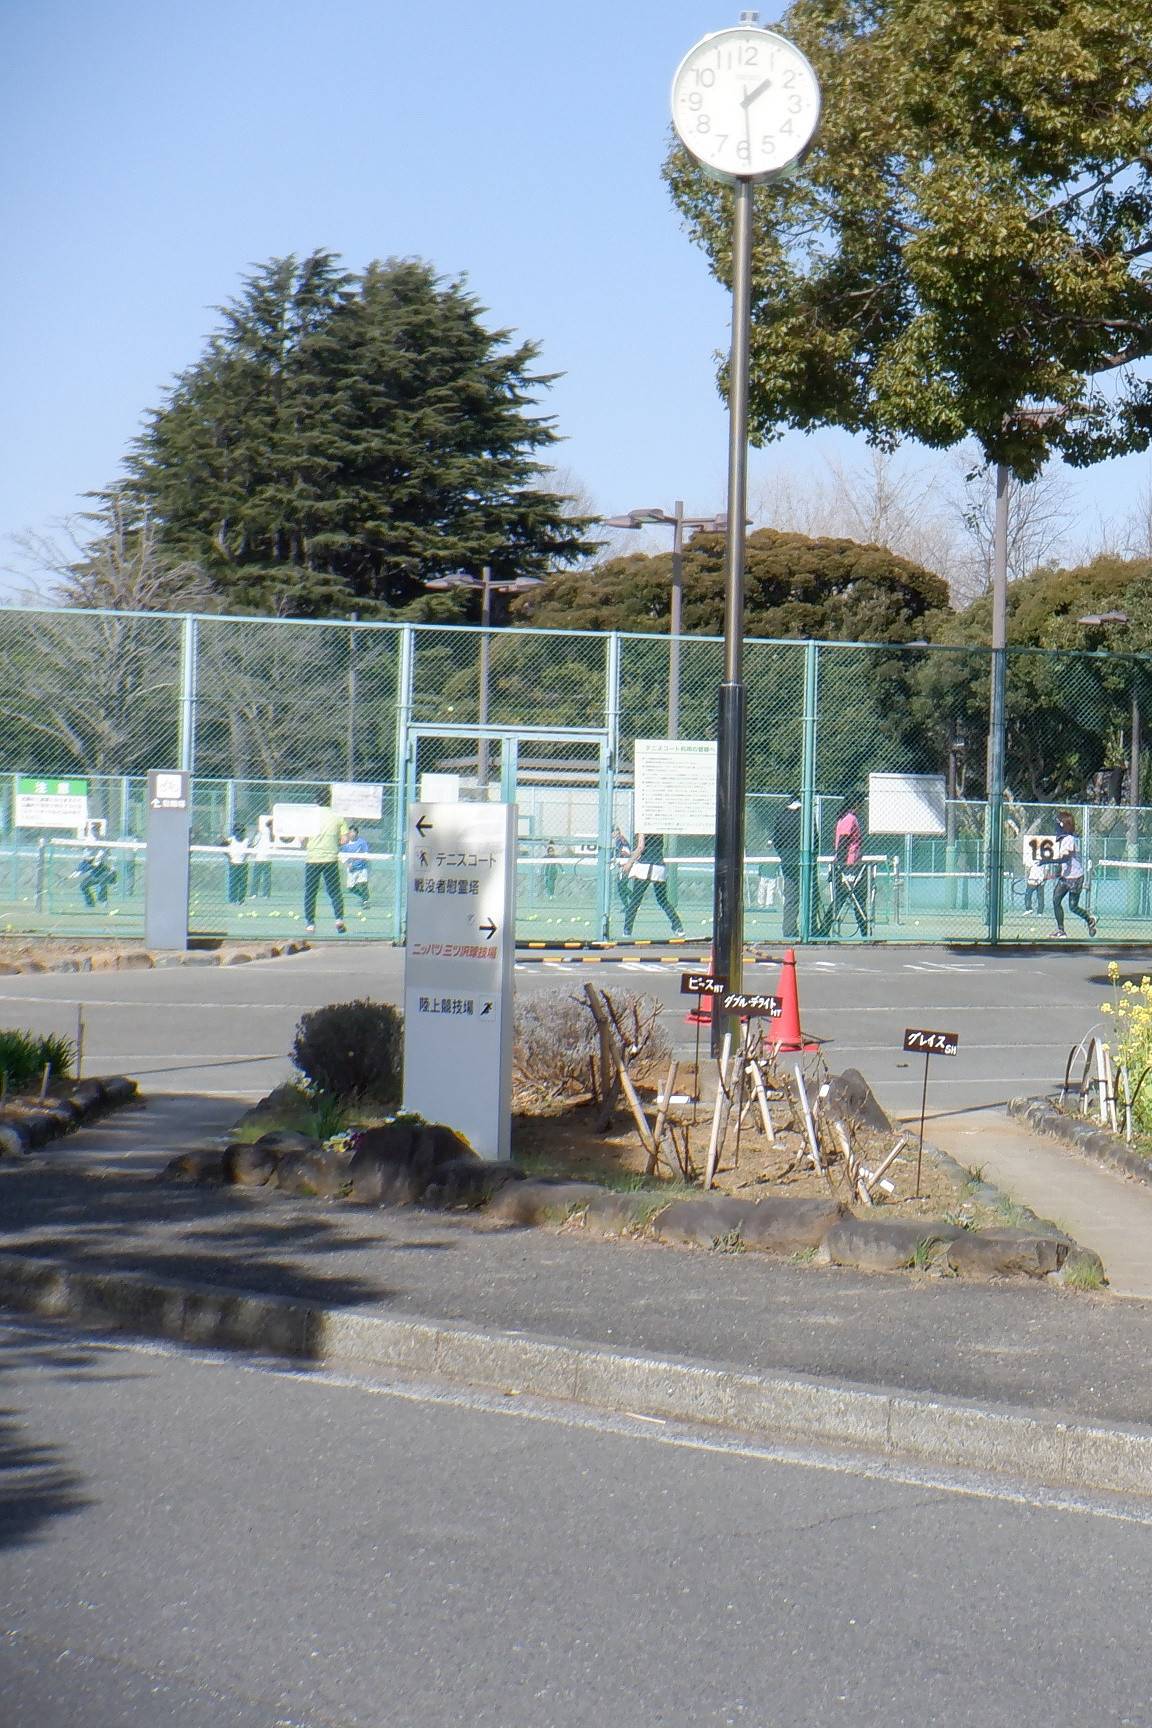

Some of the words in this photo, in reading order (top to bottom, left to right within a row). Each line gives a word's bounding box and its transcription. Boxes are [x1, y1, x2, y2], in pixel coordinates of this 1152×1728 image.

[717, 50, 732, 70] 11
[738, 45, 758, 66] 12
[770, 52, 775, 72] 1
[690, 68, 716, 88] 10
[783, 70, 796, 89] 2
[688, 92, 703, 111] 9
[788, 94, 802, 114] 3
[696, 114, 711, 134] 8
[779, 118, 794, 136] 4
[715, 134, 729, 153] 7
[736, 140, 751, 160] 6
[761, 135, 776, 154] 5
[435, 852, 497, 868] テニスコート
[1028, 839, 1055, 861] 16
[908, 1032, 946, 1048] グレイス
